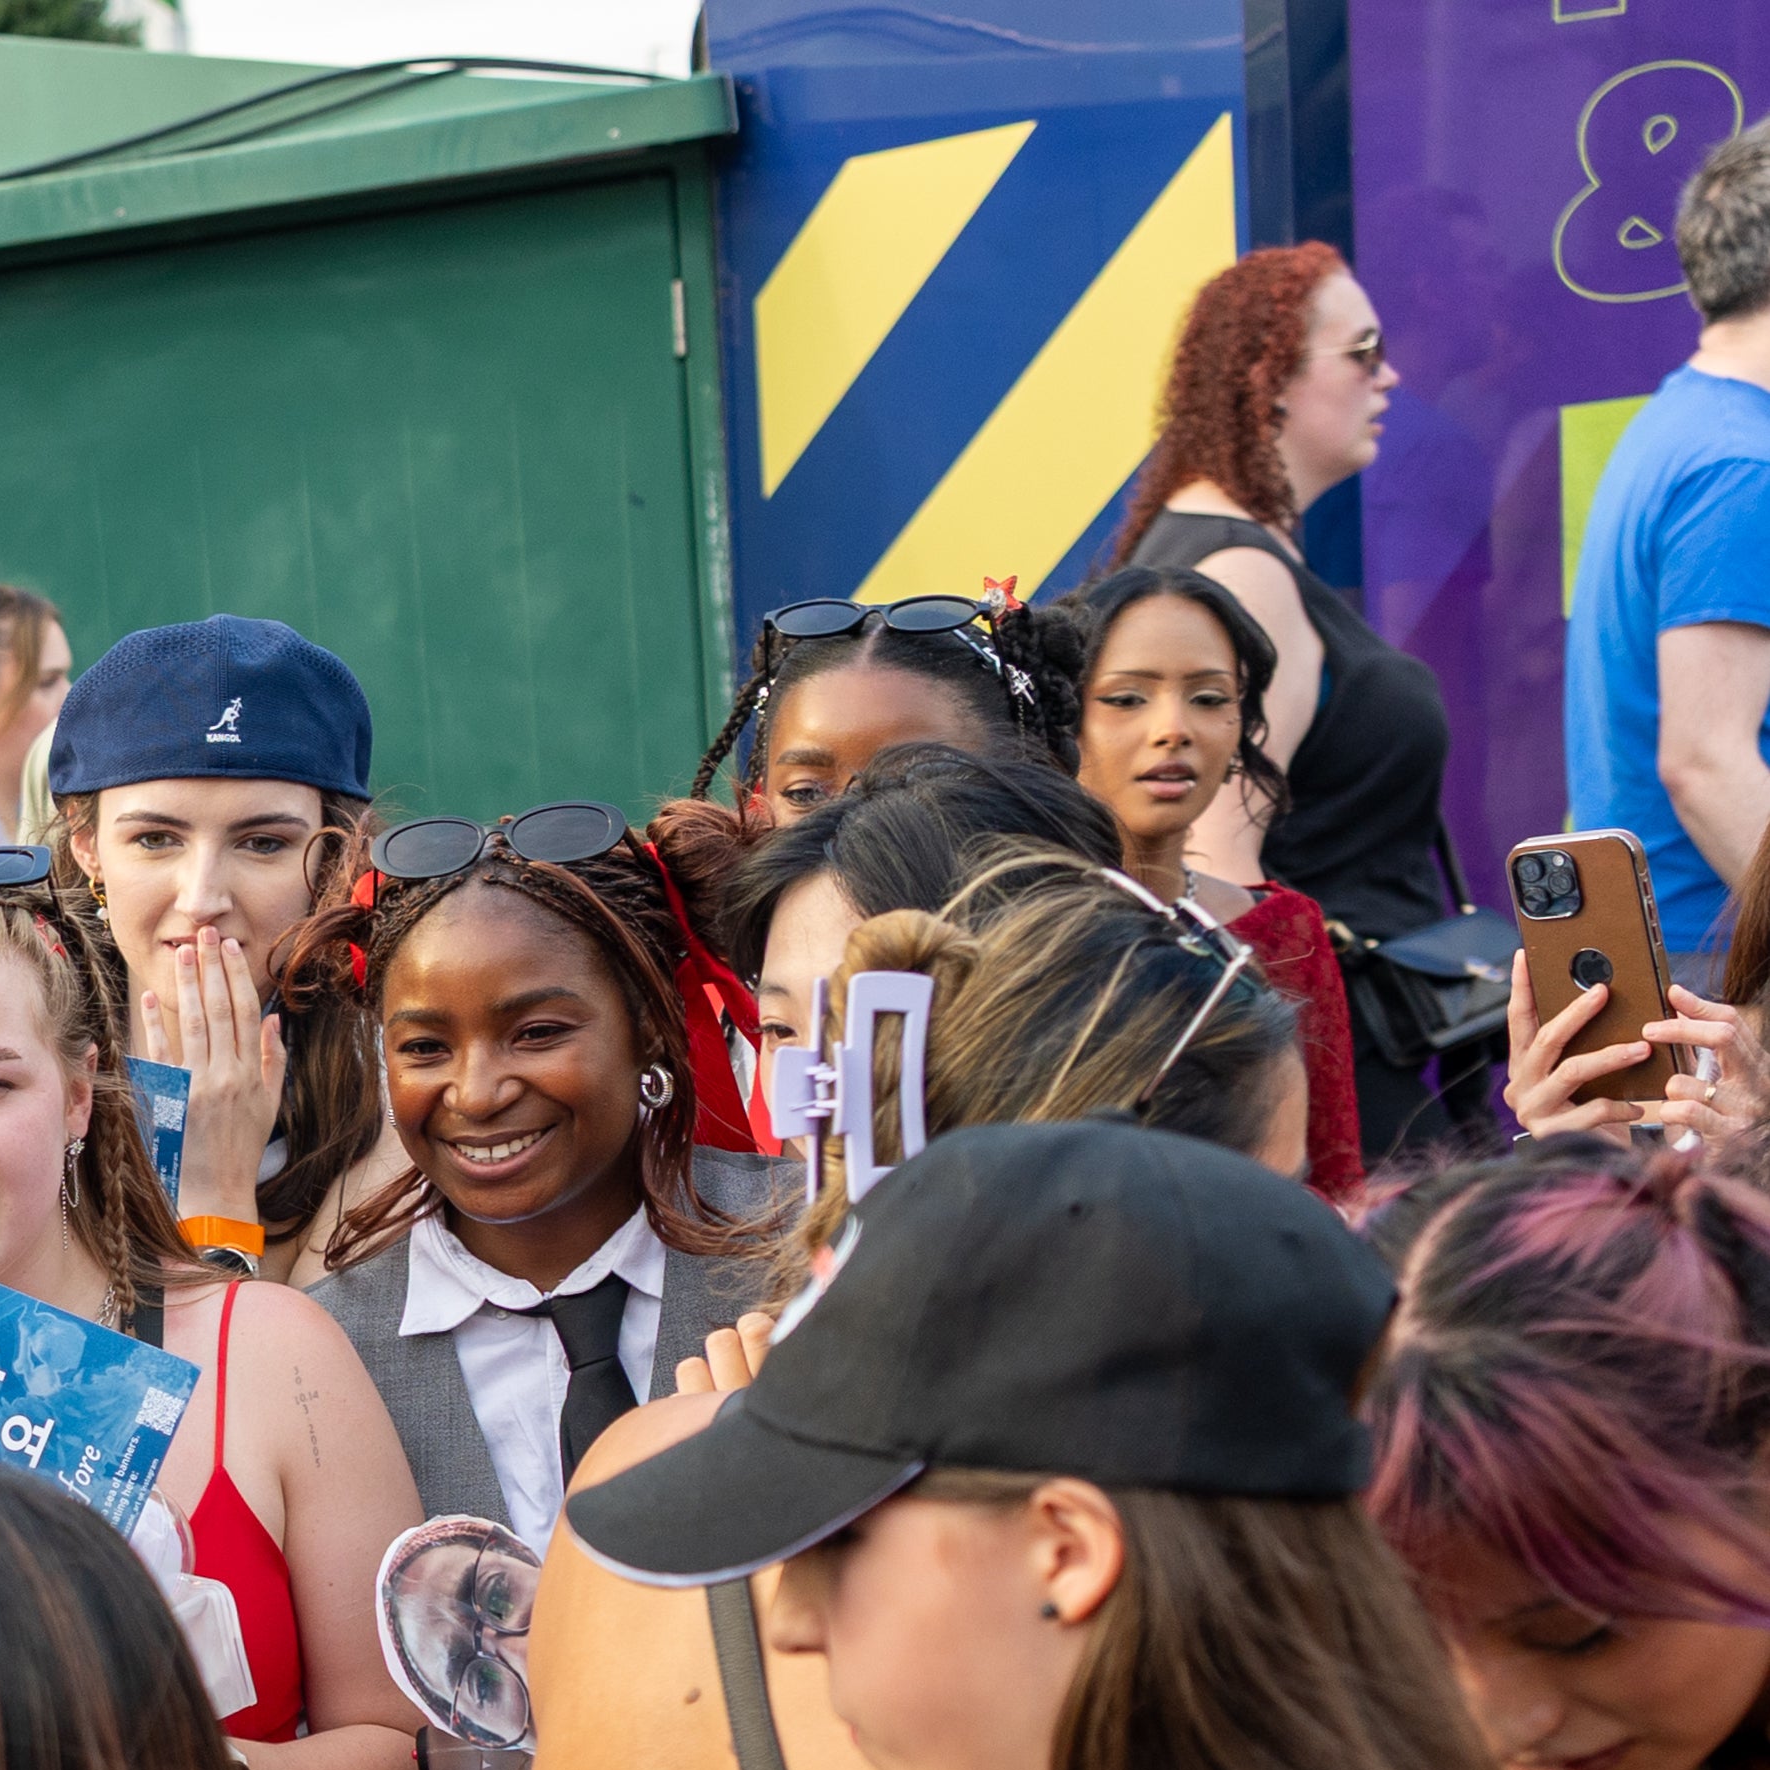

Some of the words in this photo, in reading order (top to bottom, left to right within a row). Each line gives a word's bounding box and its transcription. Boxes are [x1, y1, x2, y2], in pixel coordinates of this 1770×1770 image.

[206, 733, 242, 743] KANGOL
[115, 1434, 141, 1478] banners.
[112, 1476, 122, 1490] of
[121, 1470, 140, 1497] here:
[141, 1457, 160, 1492] Instagram
[104, 1489, 117, 1508] sea
